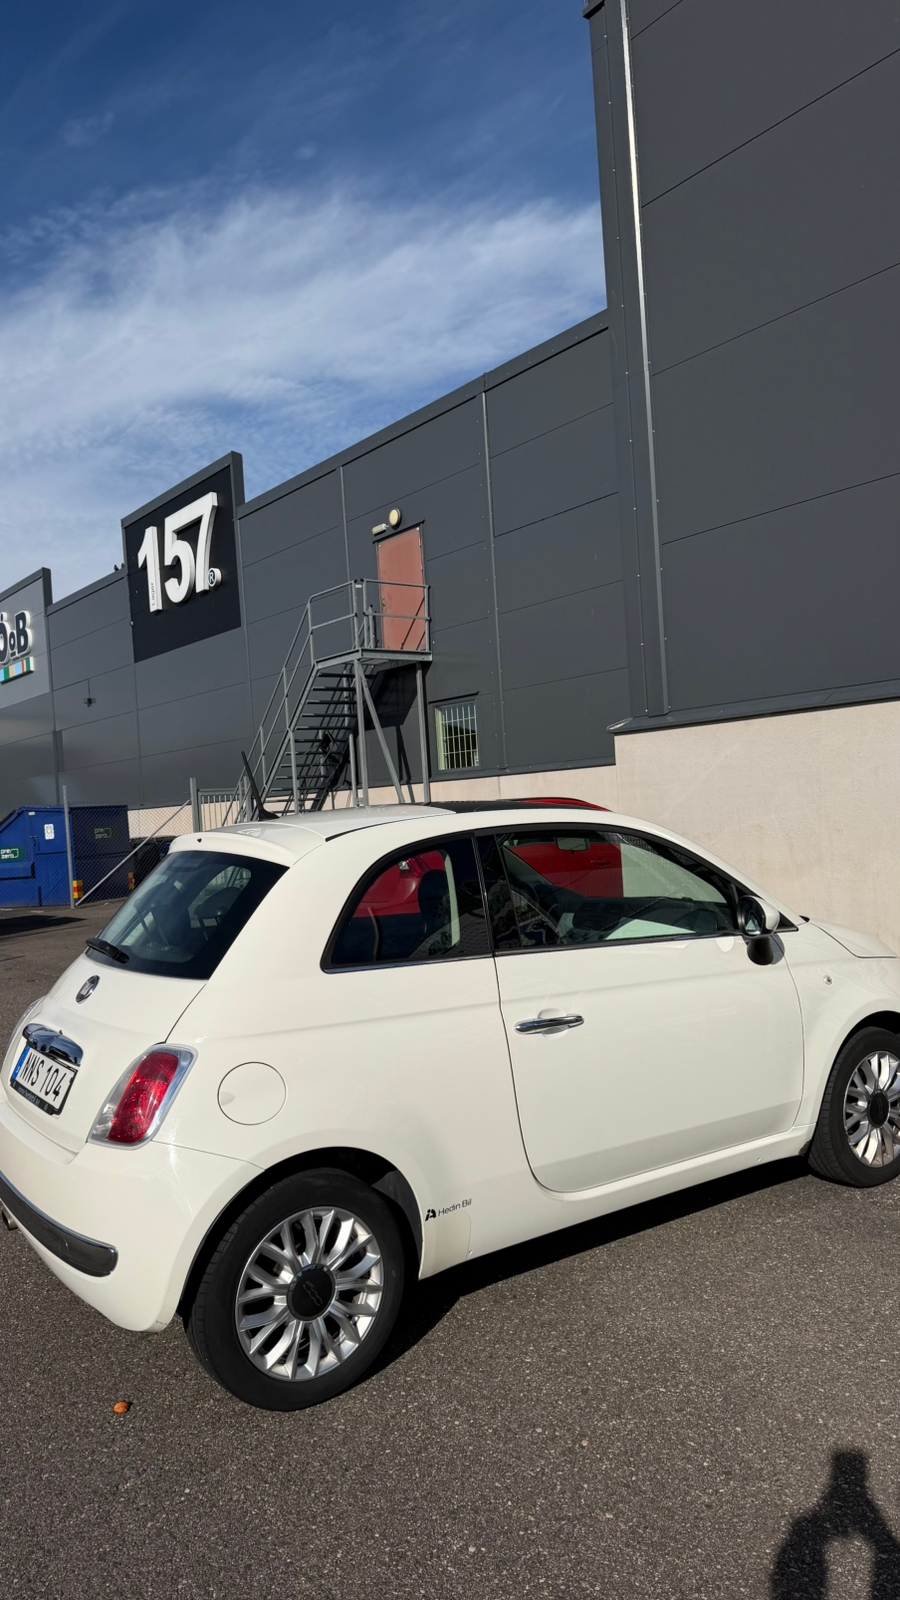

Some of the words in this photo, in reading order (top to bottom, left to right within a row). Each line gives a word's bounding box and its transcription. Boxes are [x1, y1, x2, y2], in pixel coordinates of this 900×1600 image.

[138, 492, 218, 612] 157
[19, 1052, 44, 1087] NNS
[39, 1064, 67, 1102] 104
[438, 1203, 460, 1216] Hedin
[462, 1198, 472, 1208] Bil
